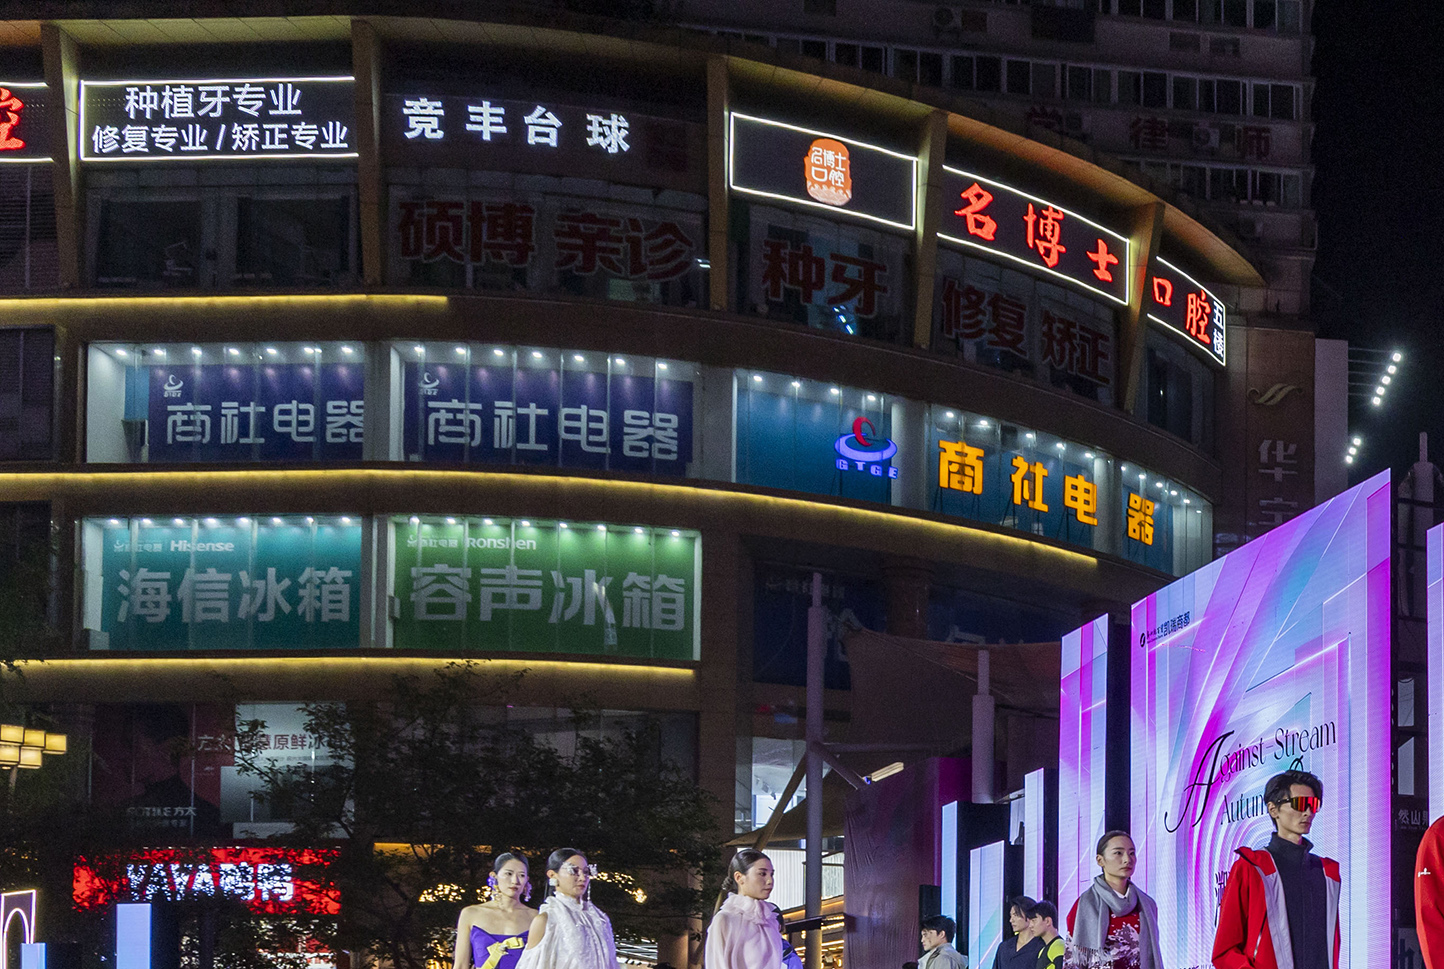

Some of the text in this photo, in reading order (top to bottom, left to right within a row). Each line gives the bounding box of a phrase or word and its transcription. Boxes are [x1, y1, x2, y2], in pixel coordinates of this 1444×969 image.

[124, 83, 303, 119] 种植牙专业
[403, 97, 630, 154] 竞丰台球
[91, 122, 349, 155] 修复专业/矫正专业
[811, 146, 847, 172] 名博士
[811, 166, 845, 188] 口腔
[954, 182, 1119, 283] 名博士
[760, 237, 890, 319] 种牙
[1152, 275, 1212, 346] 口腔
[166, 400, 364, 445] 商社电器
[427, 399, 679, 461] 商社电器
[938, 440, 1156, 546] 商社电器
[170, 540, 235, 552] Hisense
[117, 567, 353, 625] 海信冰箱
[410, 563, 687, 632] 容声冰箱
